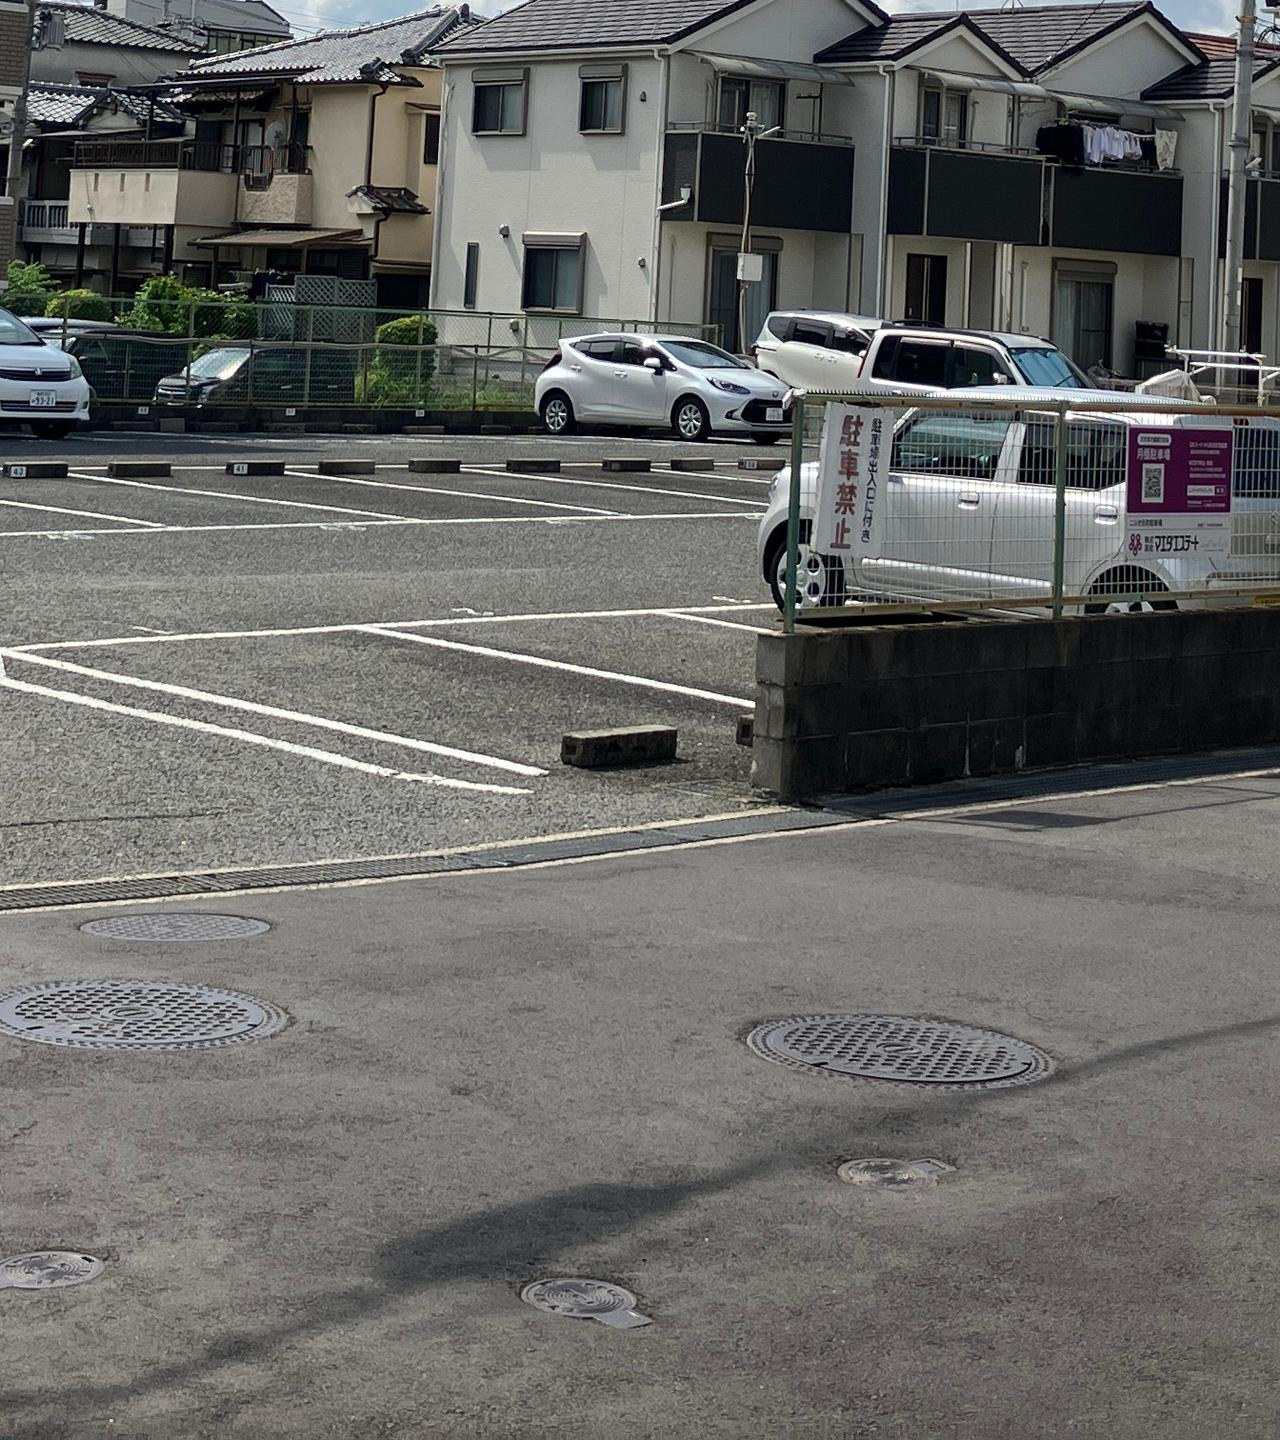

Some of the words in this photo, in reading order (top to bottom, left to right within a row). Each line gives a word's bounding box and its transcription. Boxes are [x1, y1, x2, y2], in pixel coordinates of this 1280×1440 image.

[236, 464, 245, 472] 41
[830, 414, 864, 550] 駐車禁止
[860, 417, 882, 544] 駐車場出入口に付き
